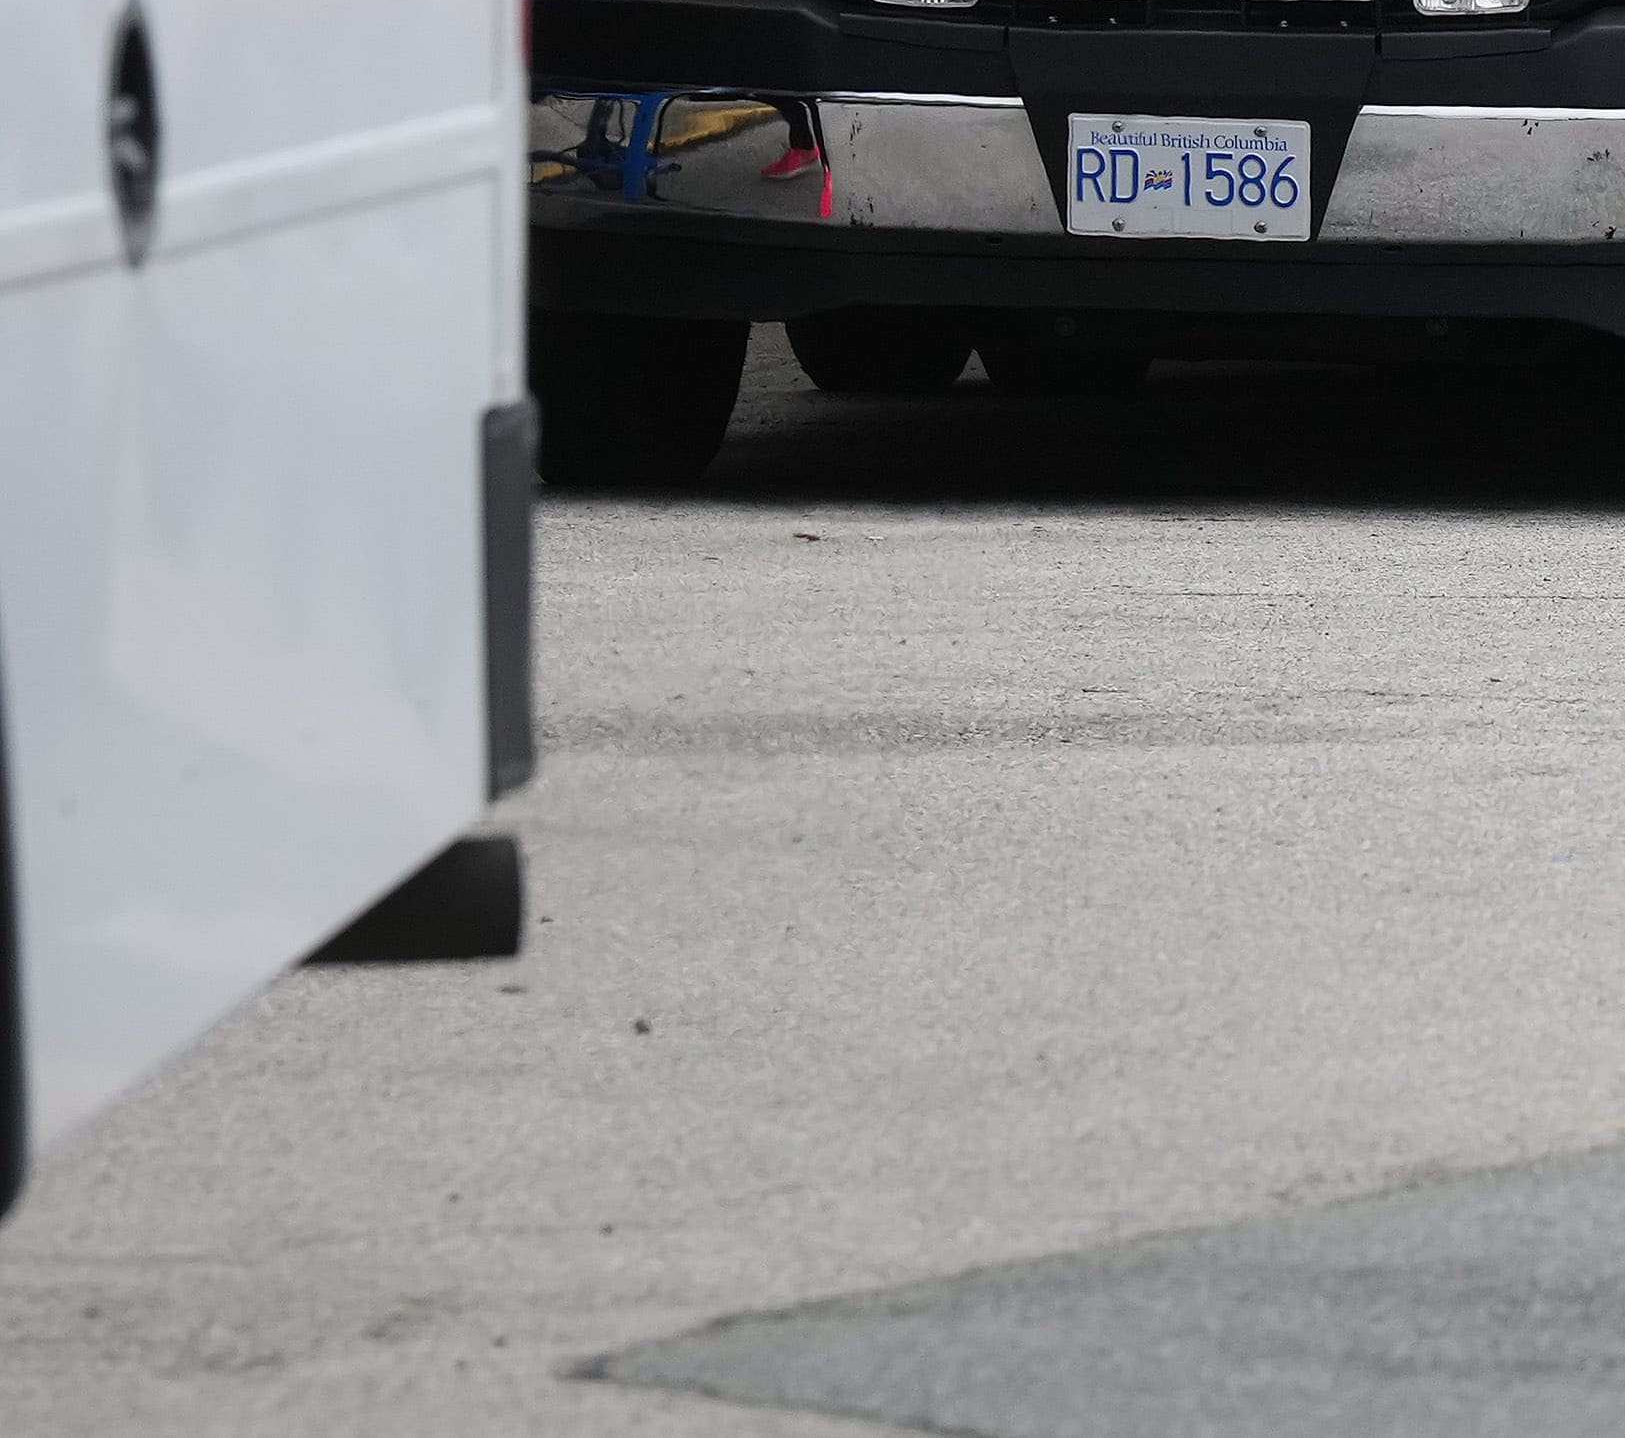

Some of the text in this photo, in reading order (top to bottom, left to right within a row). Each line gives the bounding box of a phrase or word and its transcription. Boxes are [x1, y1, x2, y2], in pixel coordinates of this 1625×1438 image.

[1090, 131, 1288, 151] Beautiful British Columbia
[1076, 147, 1299, 209] RD 1586
